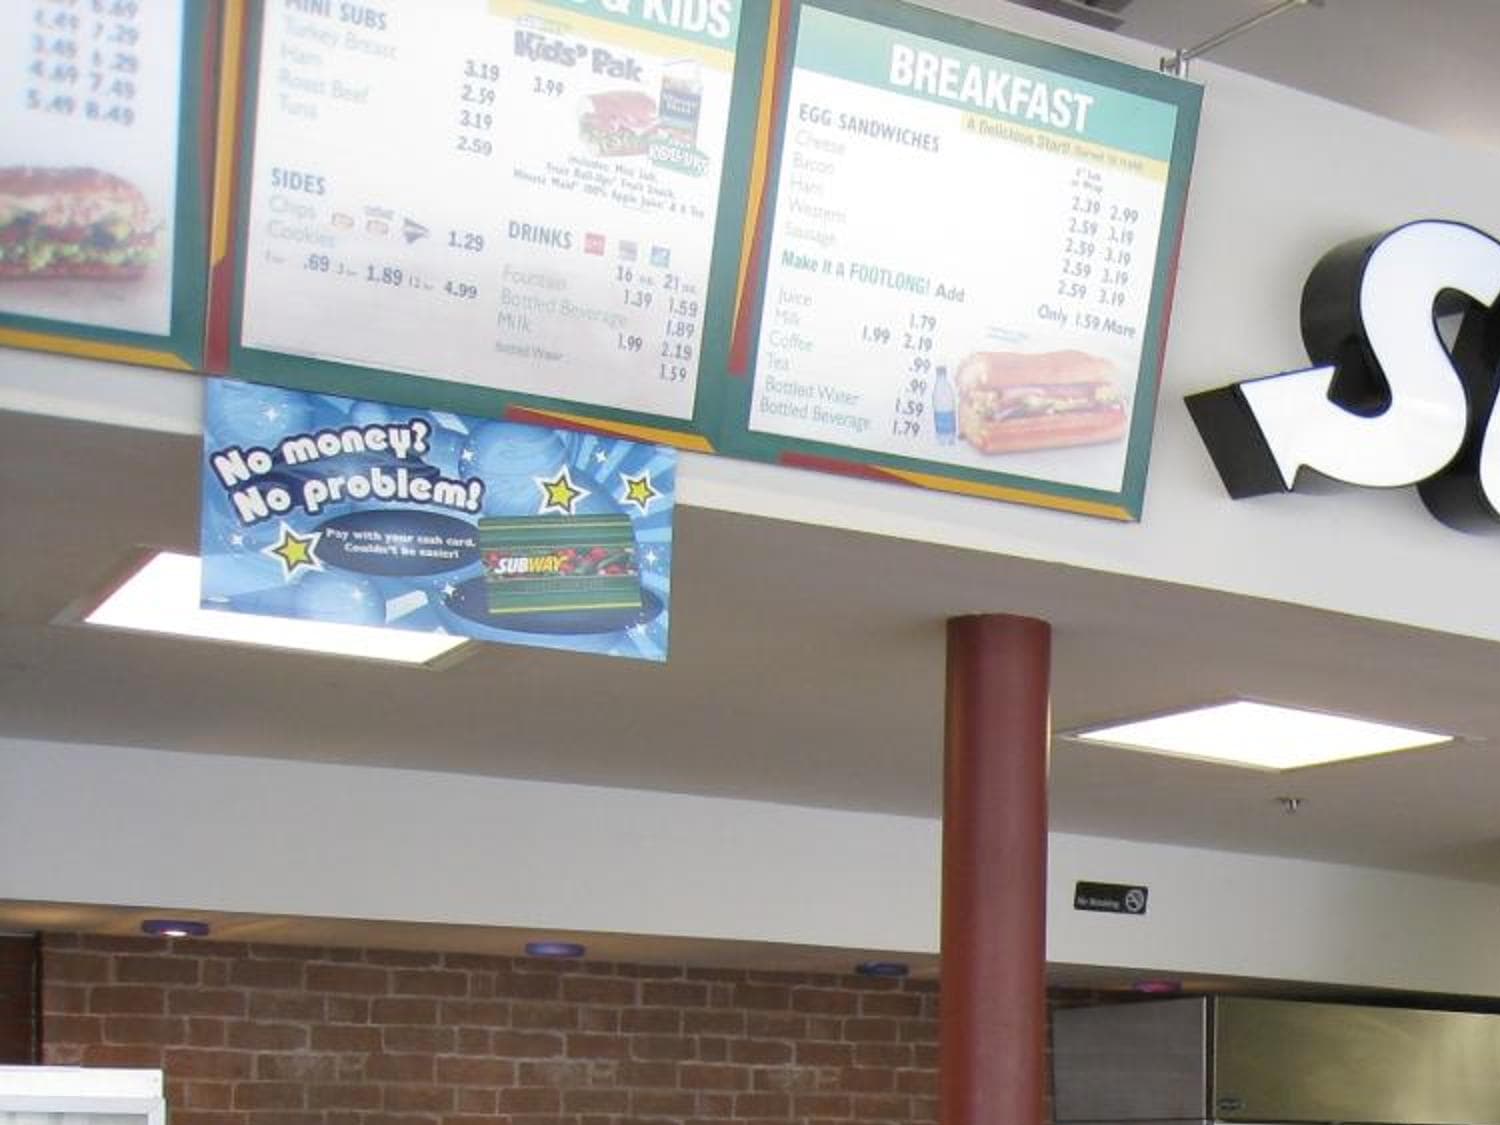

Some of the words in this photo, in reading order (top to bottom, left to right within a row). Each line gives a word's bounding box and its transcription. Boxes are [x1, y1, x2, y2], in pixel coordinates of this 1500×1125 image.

[339, 3, 387, 31] SUBS
[643, 0, 733, 39] KIDS
[464, 59, 500, 82] 3.19
[591, 47, 643, 82] Pak
[888, 43, 1096, 134] BREAKFAST
[459, 108, 495, 130] 3.19
[799, 103, 832, 128] EGG
[838, 112, 941, 153] SANDWICHES
[271, 167, 326, 195] SIDES
[1110, 204, 1139, 224] 2.99
[448, 230, 484, 252] 1.29
[508, 219, 574, 250] DRINKS
[366, 264, 402, 286] 1.89
[443, 280, 478, 299] 4.99
[781, 247, 819, 272] Make
[835, 261, 845, 280] A
[849, 263, 931, 296] FOOTLONG!
[934, 282, 966, 304] Add
[1037, 303, 1067, 329] Only
[1075, 312, 1100, 331] 1.59
[1102, 317, 1137, 340] More
[669, 297, 699, 318] 1.59
[665, 320, 695, 339] 1.89
[908, 311, 938, 333] 1.79
[861, 324, 892, 345] 1.99
[617, 333, 643, 353] 1.99
[661, 341, 693, 361] 2.19
[658, 363, 688, 382] 1.59
[895, 397, 925, 418] 1.59
[892, 420, 921, 440] 1.79
[211, 446, 272, 488] No
[281, 418, 431, 463] money?
[232, 486, 292, 525] No
[303, 466, 485, 515] problem!
[326, 528, 349, 541] Pay
[352, 531, 382, 541] with
[384, 533, 414, 545] your
[400, 546, 417, 557] be
[493, 555, 570, 574] SUBWAY
